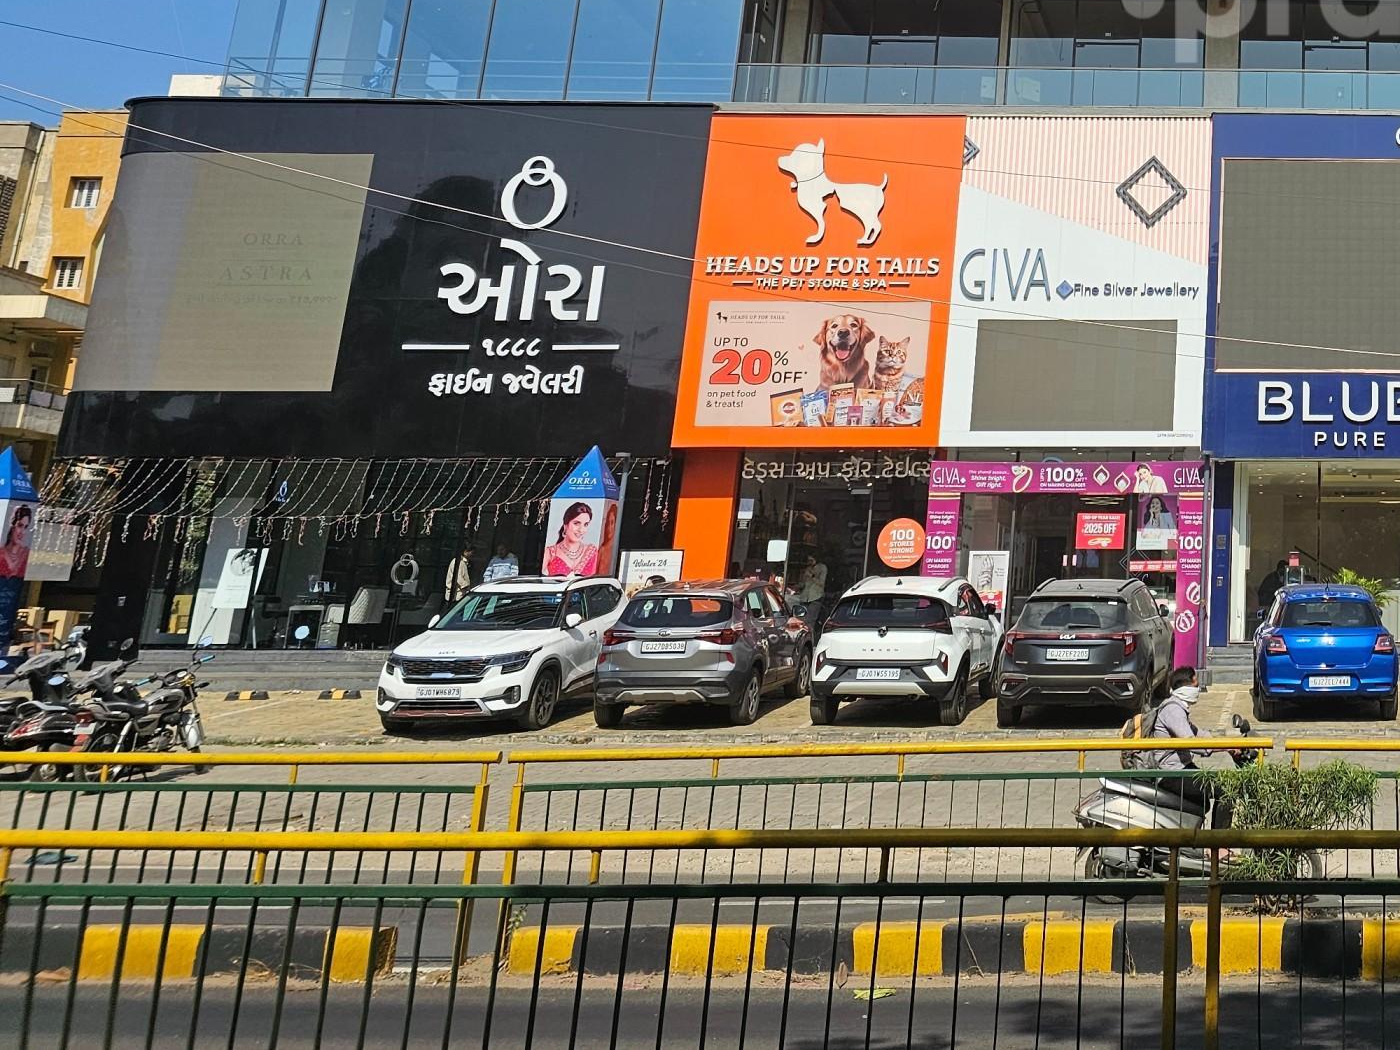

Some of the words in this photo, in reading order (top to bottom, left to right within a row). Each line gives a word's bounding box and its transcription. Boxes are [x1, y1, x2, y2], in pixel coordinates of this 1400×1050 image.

[243, 232, 304, 246] ORRA
[220, 265, 312, 281] ASTRA
[705, 256, 784, 274] HEADS
[789, 257, 821, 275] UP
[826, 257, 871, 275] FOR
[876, 258, 940, 276] TAILS
[437, 238, 606, 321] ઓરા
[959, 248, 1051, 302] GIVA
[1073, 283, 1100, 298] Fine
[1103, 282, 1138, 298] Silver
[1140, 283, 1200, 300] Jewellery
[756, 278, 779, 289] THE
[781, 278, 805, 289] PET
[808, 278, 849, 289] STORE
[851, 278, 861, 289] &
[863, 278, 887, 289] SPA
[713, 337, 731, 347] UP
[733, 337, 749, 347] TO
[428, 367, 494, 397] ફાઈન
[720, 390, 735, 399] pet
[736, 389, 757, 398] food
[714, 400, 744, 408] treats!
[1313, 431, 1387, 447] PURE
[795, 461, 831, 479] અપ
[932, 467, 961, 484] GIVA
[1045, 467, 1084, 483] 100%
[1173, 468, 1201, 484] GIVA
[568, 477, 597, 485] ORRA
[890, 529, 915, 541] 100
